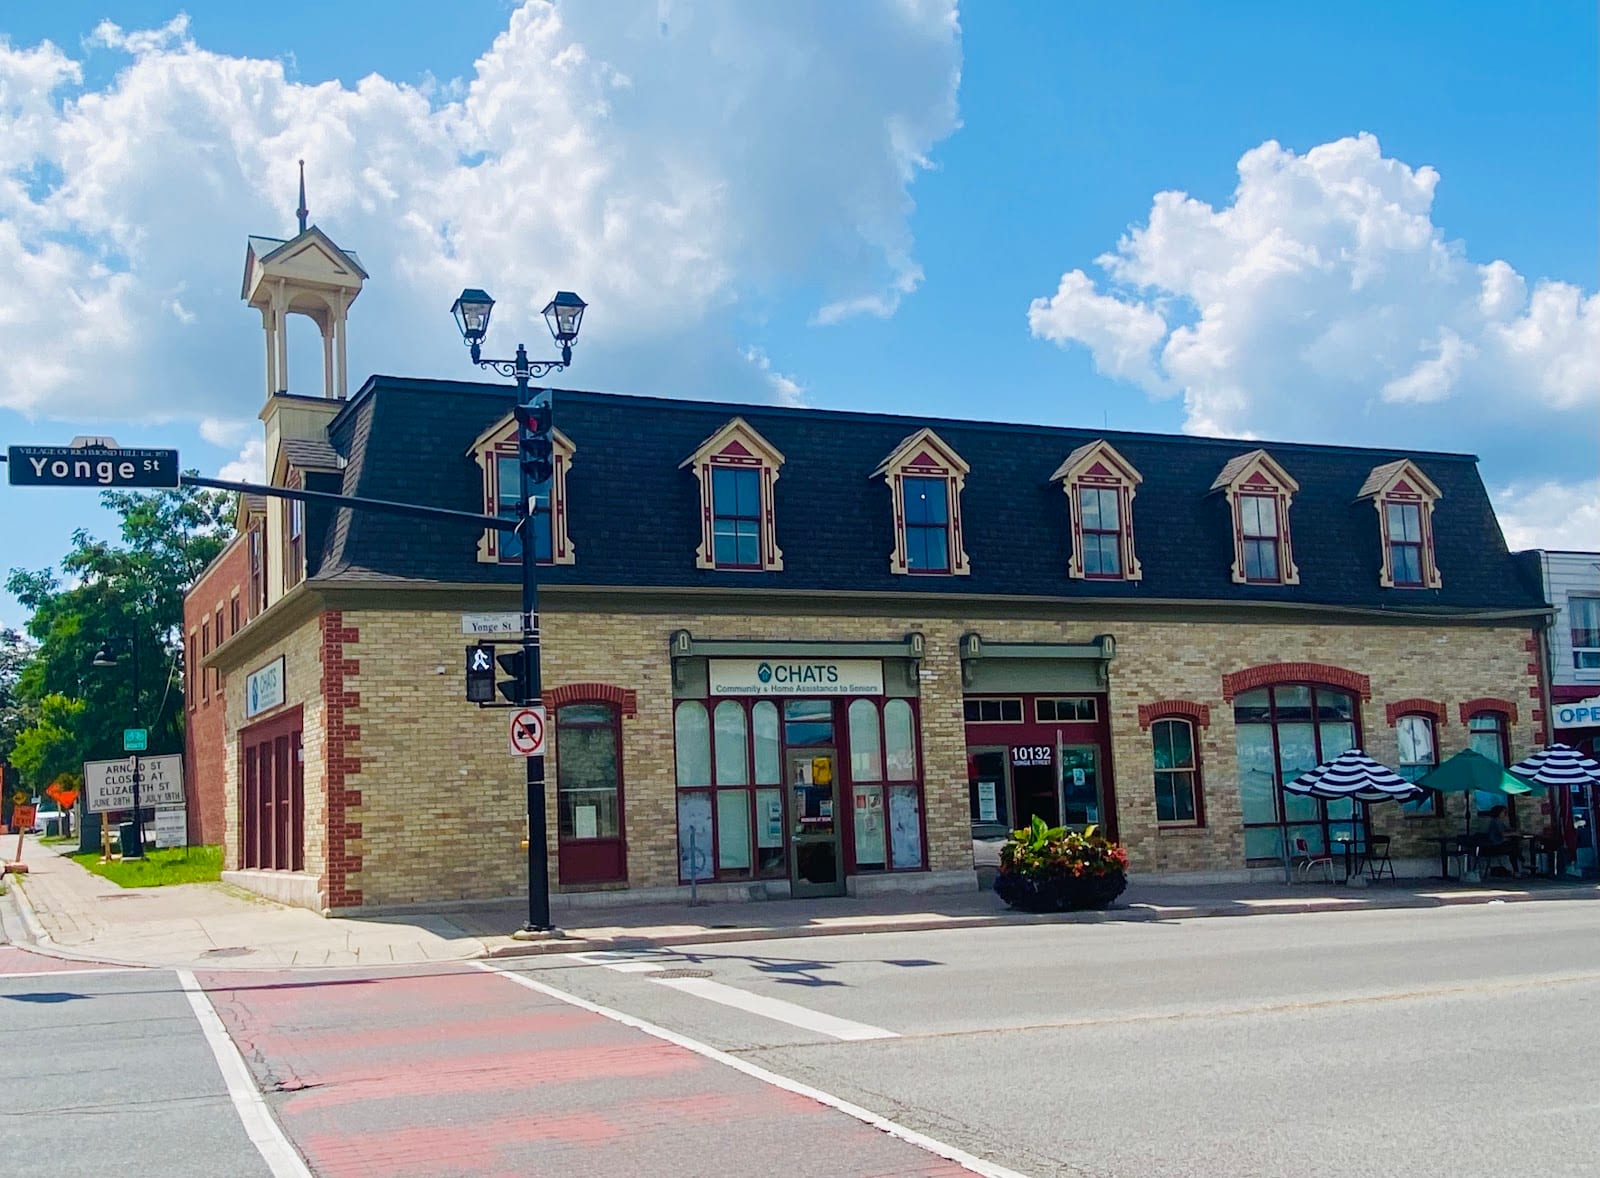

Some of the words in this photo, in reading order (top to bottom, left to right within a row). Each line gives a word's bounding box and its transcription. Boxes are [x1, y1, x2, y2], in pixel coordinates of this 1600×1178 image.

[29, 457, 136, 484] Yonge
[143, 460, 160, 471] St
[472, 622, 498, 633] Yonge
[502, 622, 512, 631] St
[774, 665, 839, 683] CHATS
[715, 684, 760, 693] Community
[771, 684, 795, 692] Home
[796, 684, 839, 692] Assistance
[840, 684, 848, 692] to
[849, 684, 878, 692] Seniors
[1012, 746, 1051, 761] 10132
[106, 763, 145, 774] ARNOD
[150, 761, 162, 770] ST
[105, 774, 145, 785] CLOSD
[151, 772, 164, 781] AT
[158, 782, 170, 791] ST
[145, 793, 161, 803] JULY
